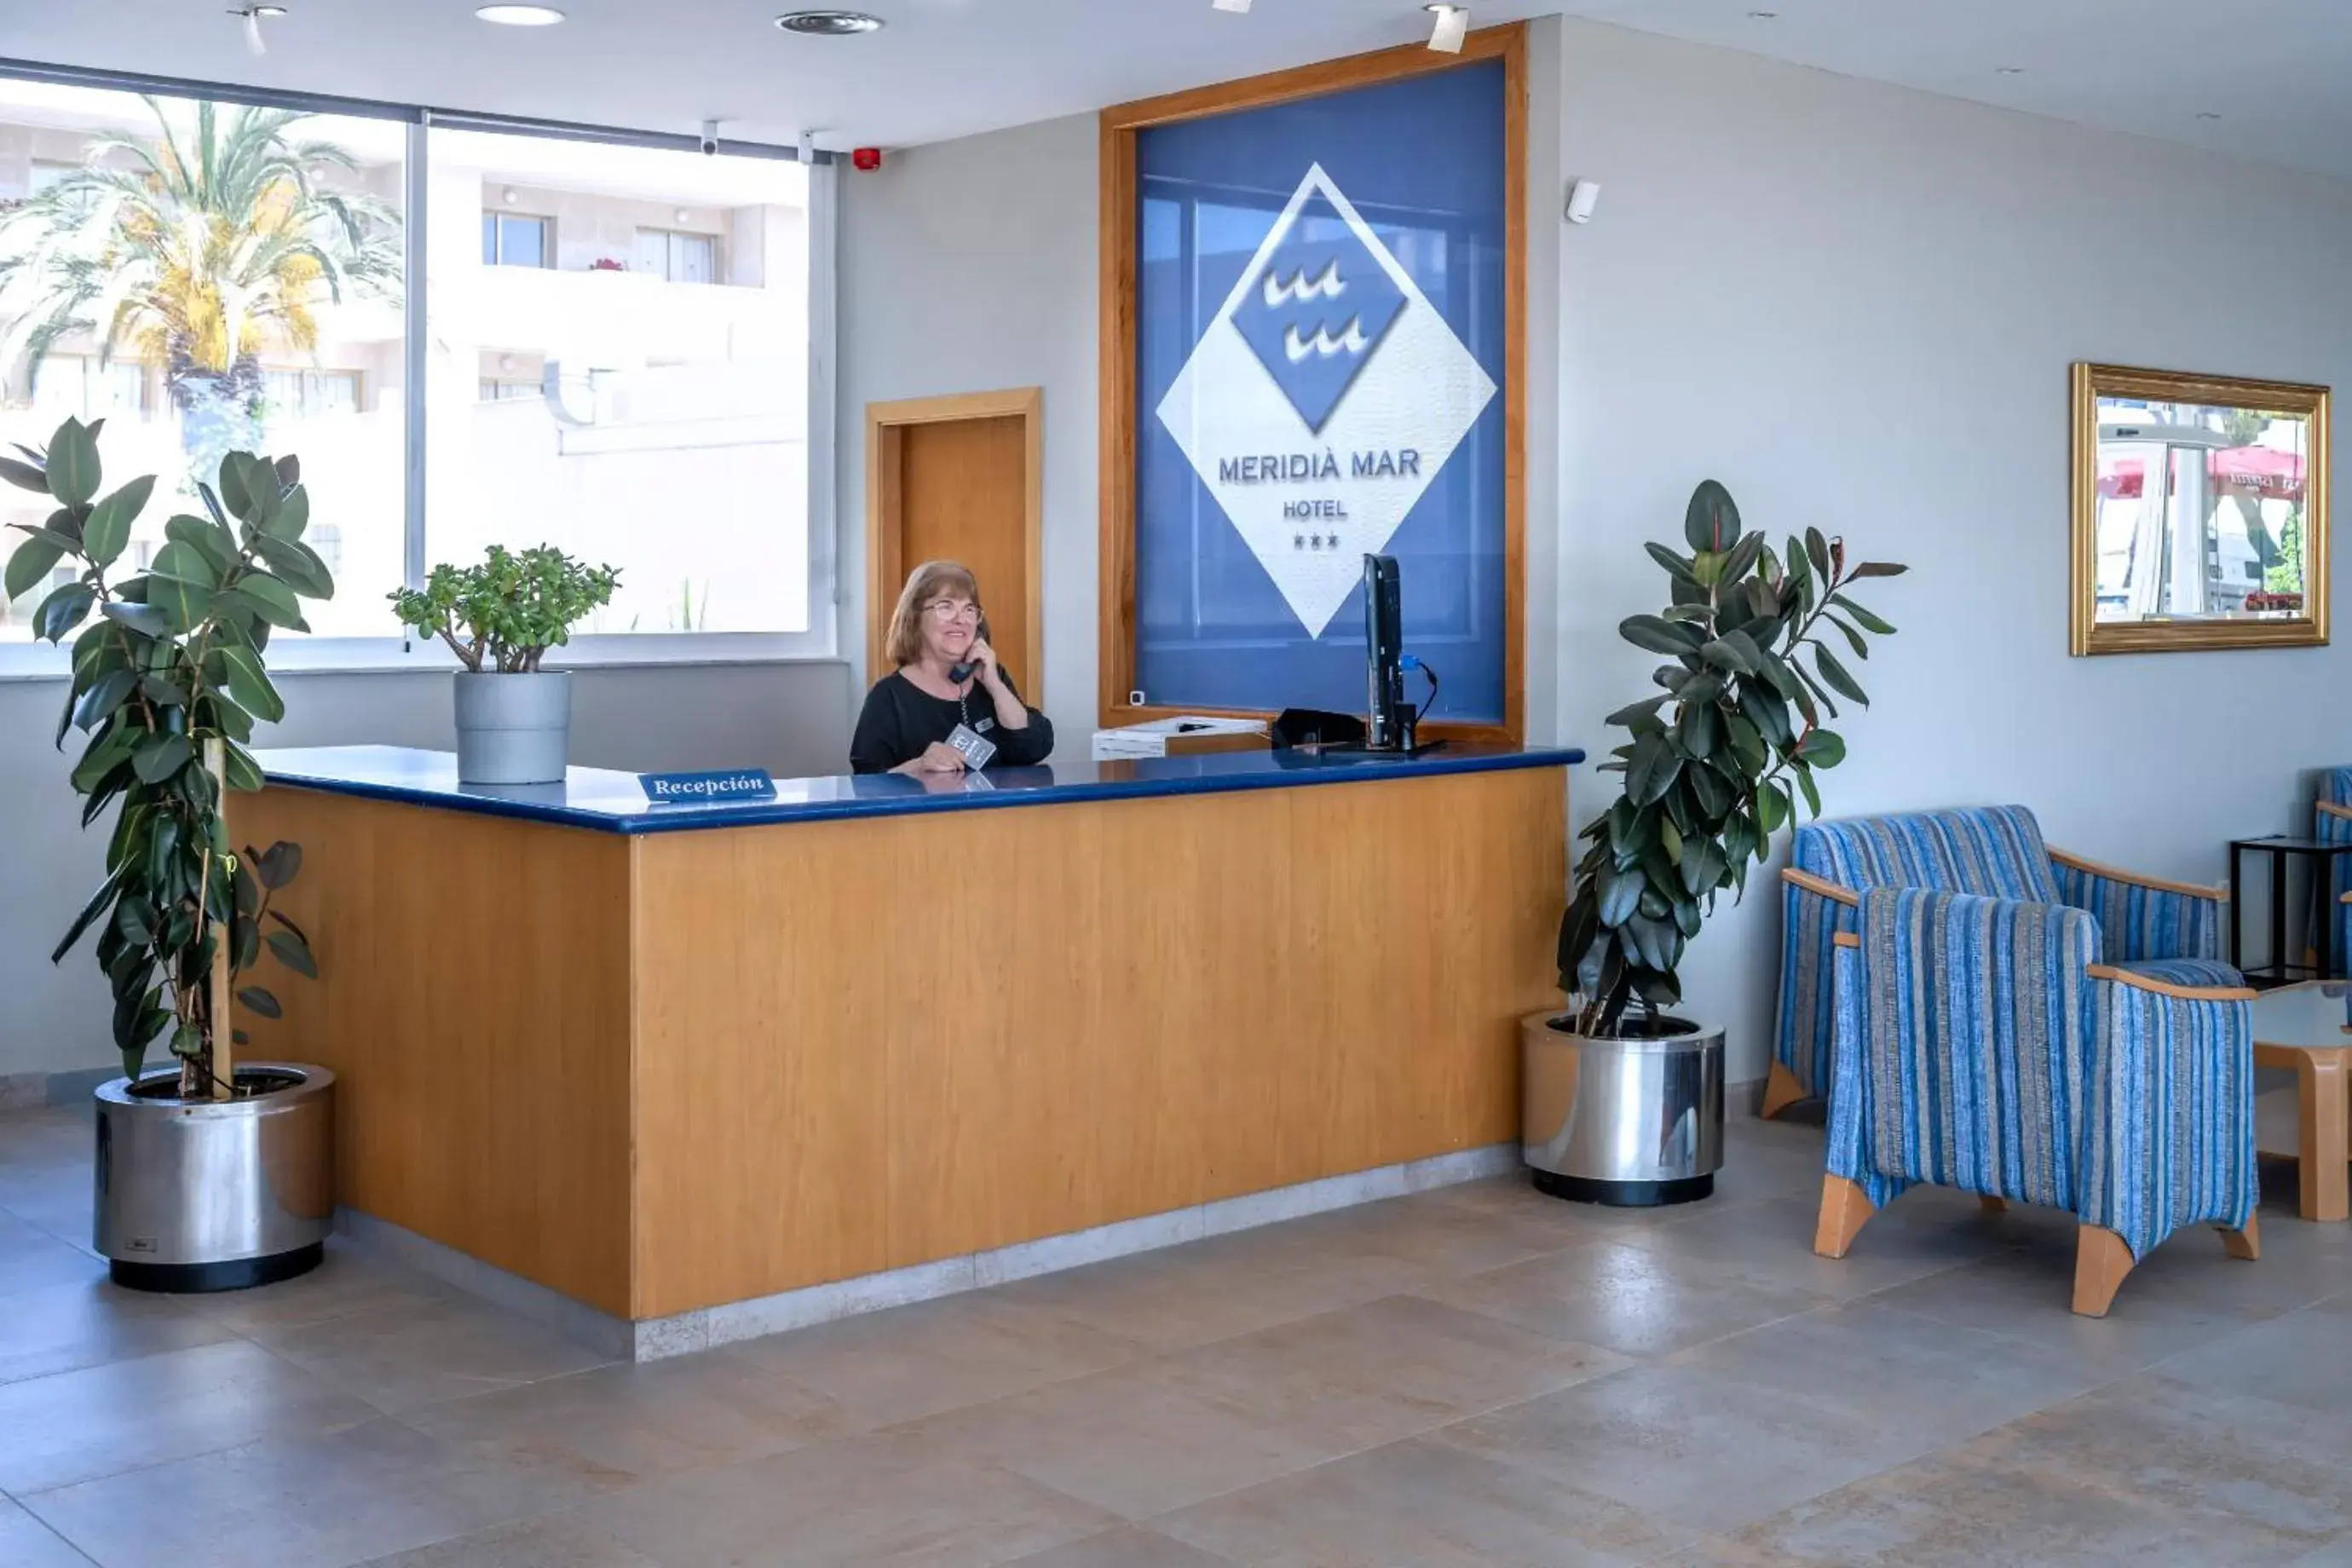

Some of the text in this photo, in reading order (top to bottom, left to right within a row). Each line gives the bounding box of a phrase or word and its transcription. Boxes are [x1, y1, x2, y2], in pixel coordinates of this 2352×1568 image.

[1219, 447, 1420, 481] MERIDIÀ MAR
[1283, 499, 1347, 518] HOTEL
[654, 775, 764, 796] Recepción
